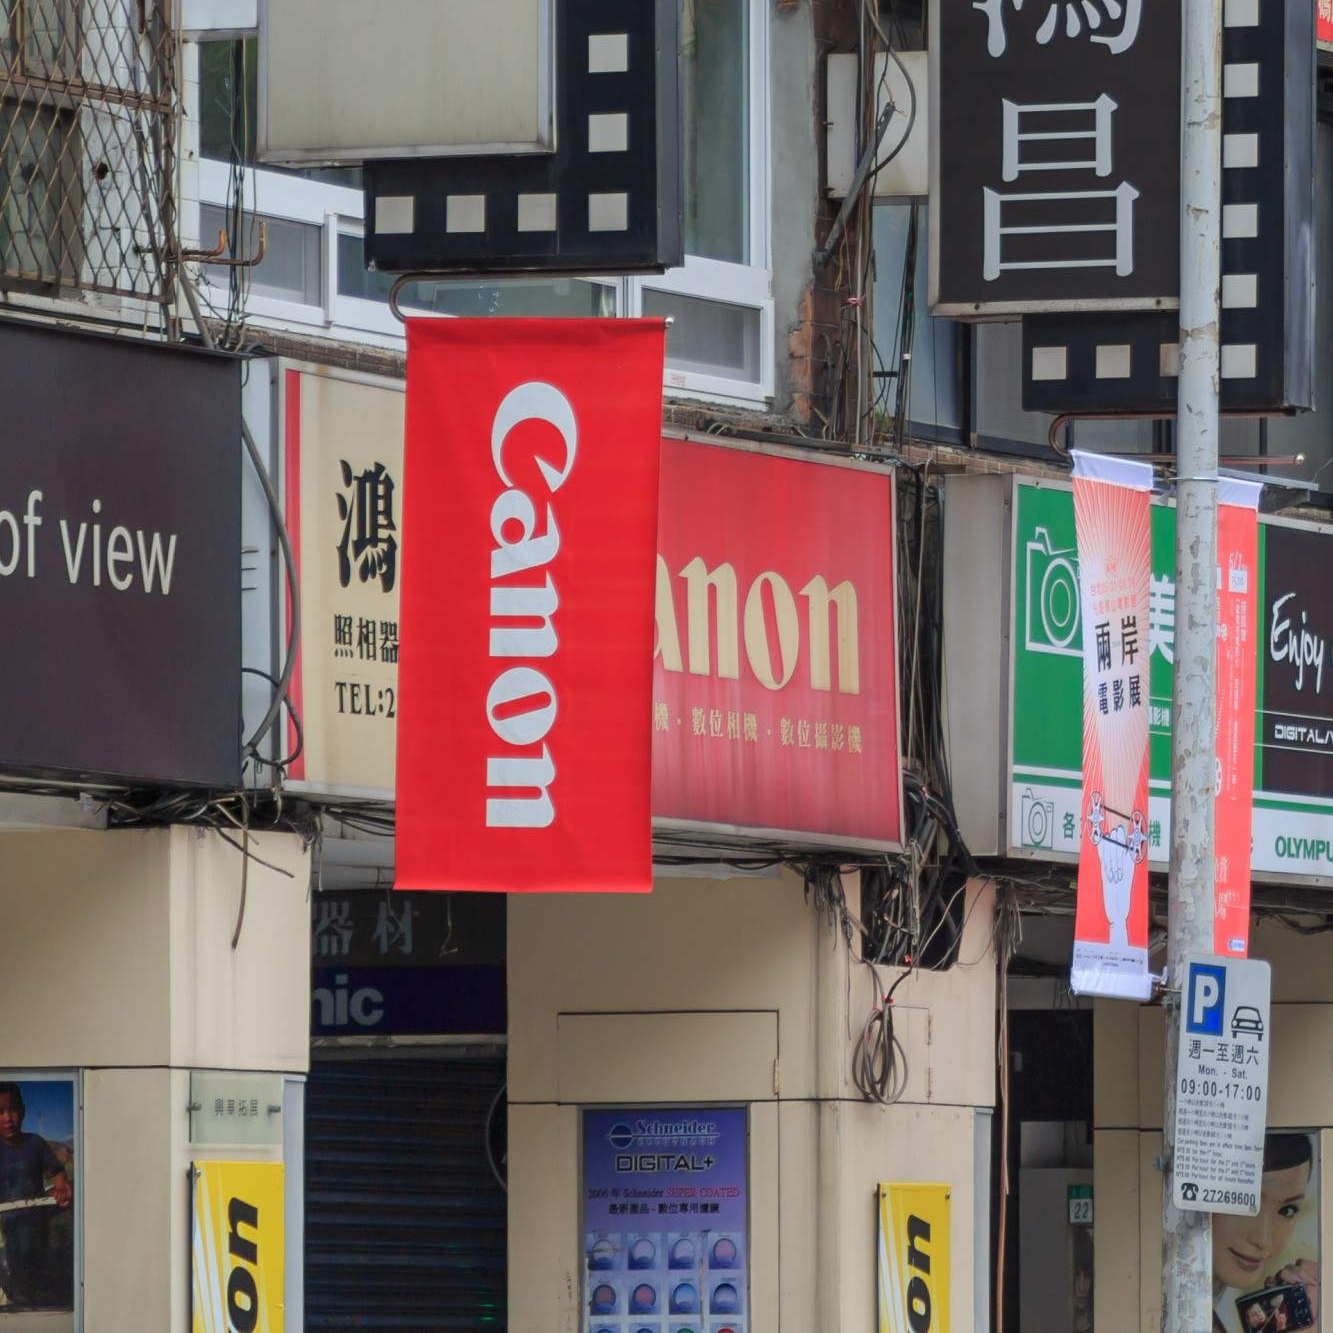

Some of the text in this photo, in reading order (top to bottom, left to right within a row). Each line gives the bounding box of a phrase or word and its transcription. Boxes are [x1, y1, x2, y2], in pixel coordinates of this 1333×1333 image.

[0, 490, 177, 595] of view
[335, 460, 397, 594] 鴻
[485, 381, 579, 829] Canon
[653, 552, 860, 695] anon
[334, 613, 399, 664] 照相器
[1095, 616, 1139, 673] 兩岸
[1270, 592, 1325, 691] Enjoy
[335, 682, 396, 718] TEL:2
[1098, 674, 1142, 715] 電影展
[1193, 975, 1219, 1024] P
[1189, 1039, 1259, 1065] 週一至週六
[1181, 1079, 1261, 1101] 09:00-17:00
[1198, 1064, 1248, 1079] Mon. Sat.
[635, 1120, 715, 1135] Schneider
[615, 1154, 714, 1172] DIGITAL+
[666, 1187, 696, 1197] SUPER
[699, 1187, 740, 1198] COATED
[1074, 1201, 1089, 1220] 22
[1203, 1189, 1256, 1207] 27269600
